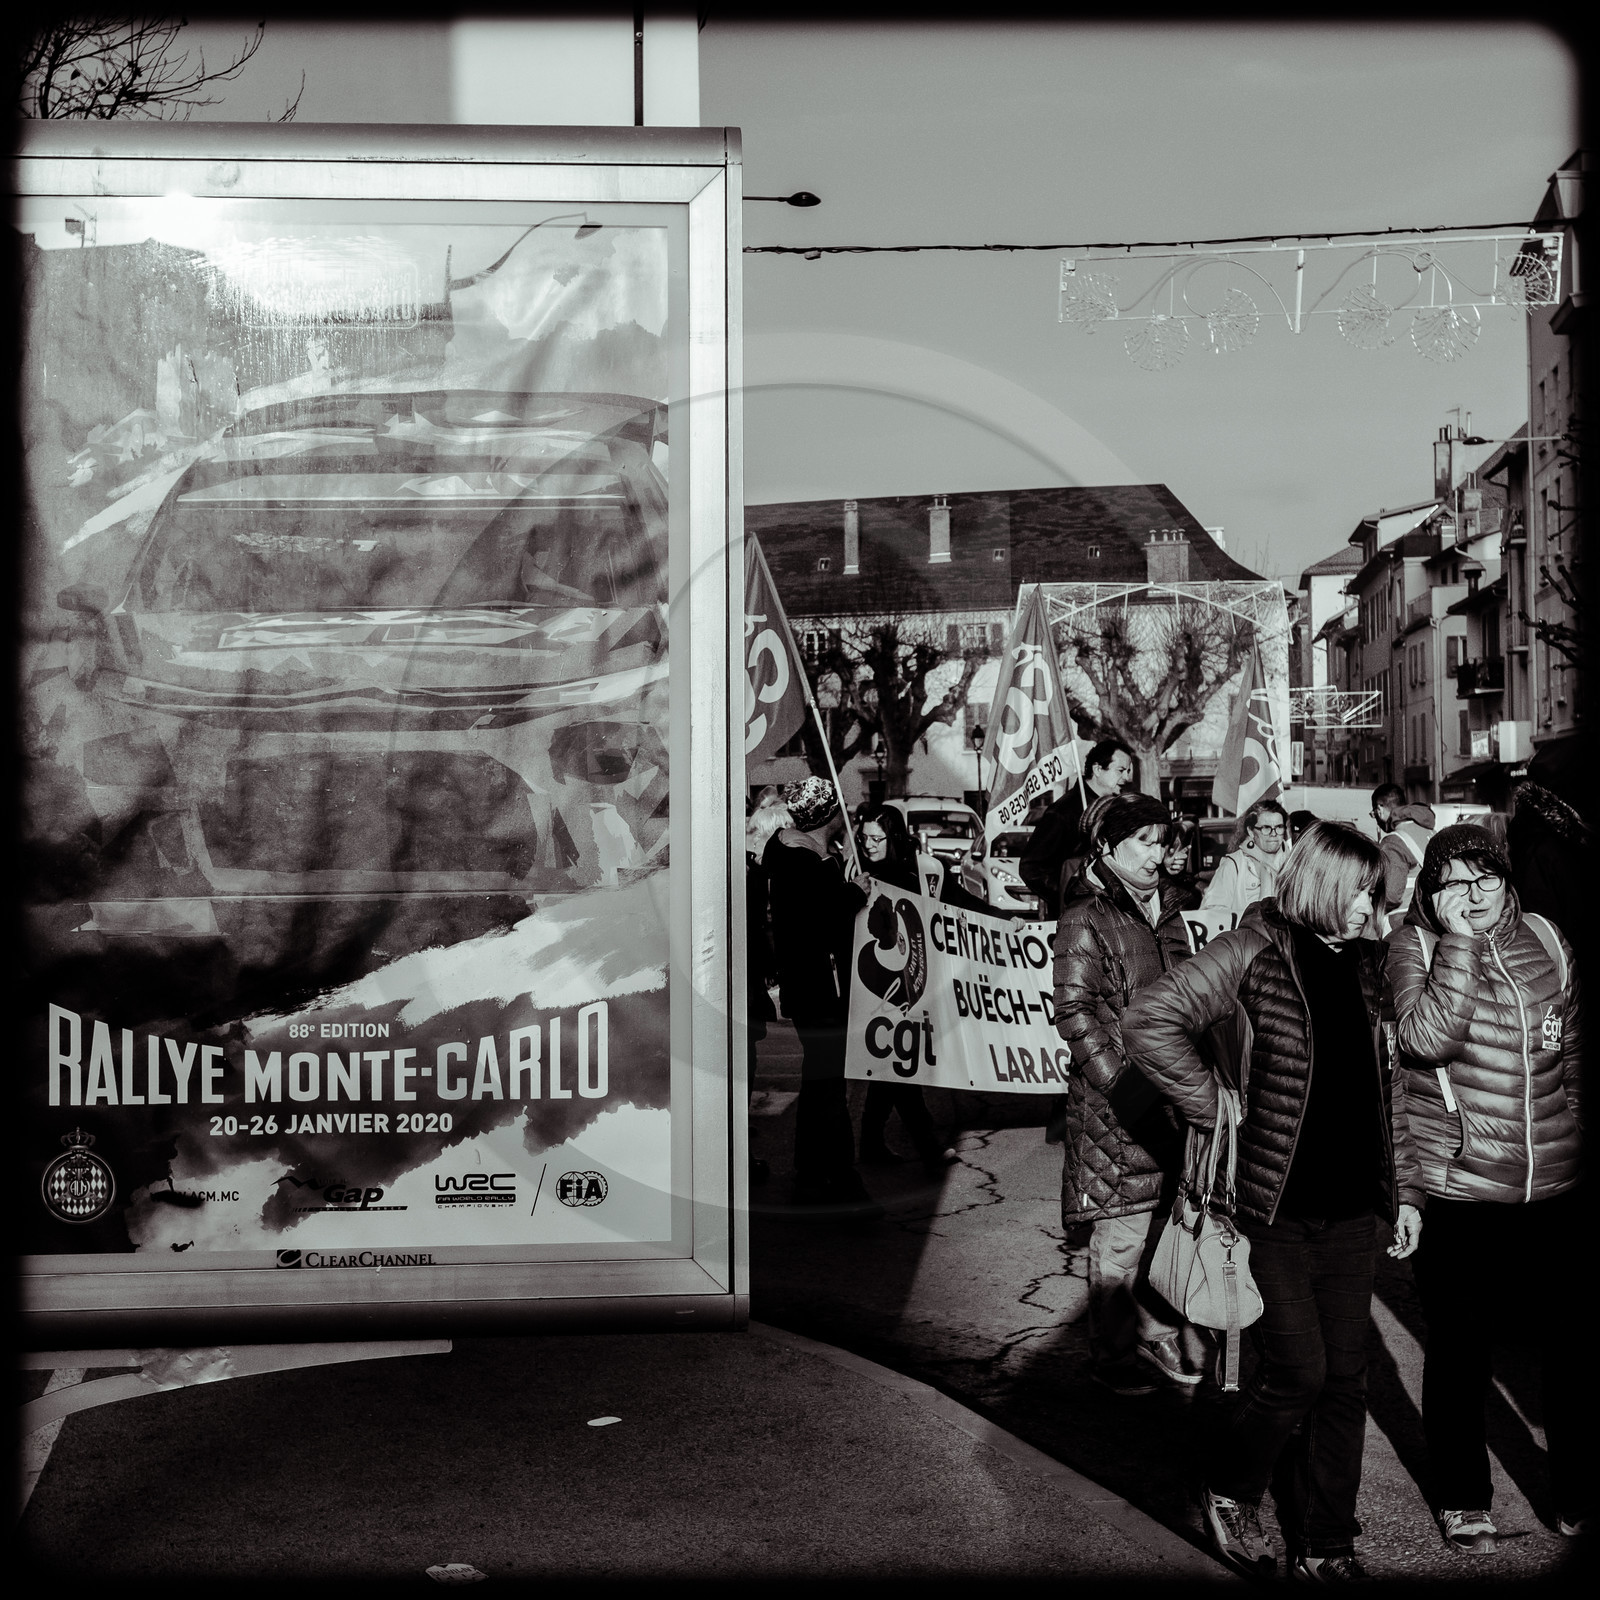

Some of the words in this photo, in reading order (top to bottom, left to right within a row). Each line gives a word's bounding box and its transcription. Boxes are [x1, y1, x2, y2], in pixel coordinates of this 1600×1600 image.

[930, 912, 1007, 968] CENTRE
[320, 1022, 390, 1039] EDITION
[1542, 1017, 1563, 1042] cgt
[49, 1003, 224, 1106] RALLYE
[245, 1000, 609, 1103] MONTE-CARLO
[865, 1010, 937, 1078] cgt
[209, 1115, 278, 1136] 20-26
[285, 1114, 390, 1135] JANVIER
[397, 1113, 453, 1133] 2020
[435, 1173, 516, 1191] WRC
[323, 1184, 384, 1211] Gap
